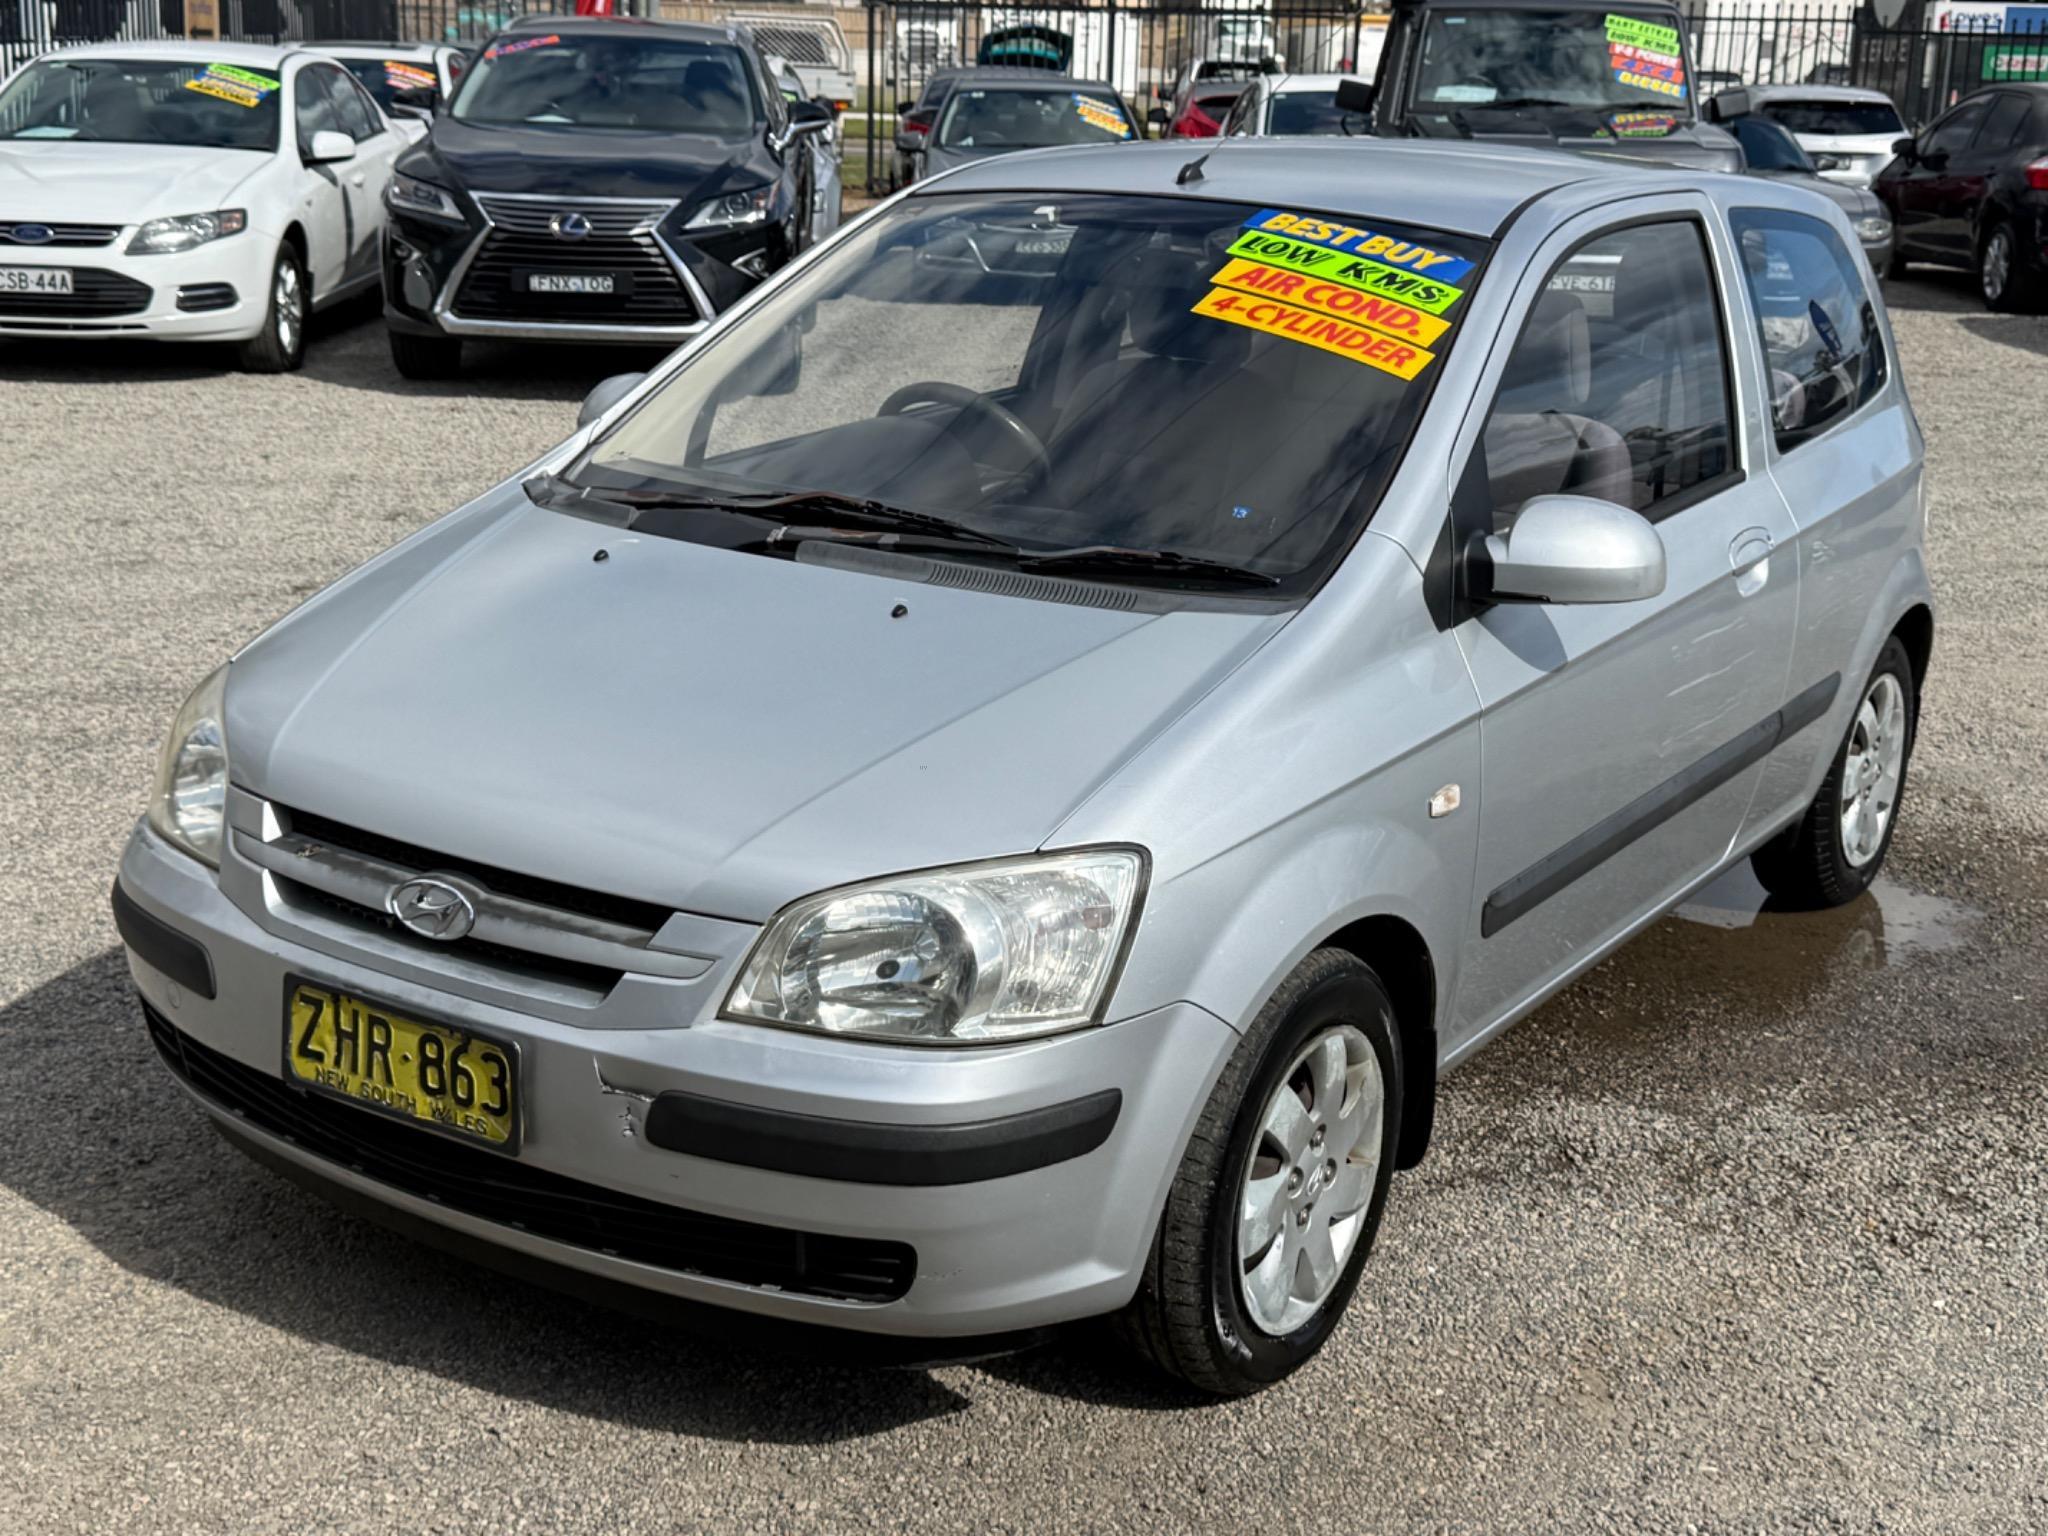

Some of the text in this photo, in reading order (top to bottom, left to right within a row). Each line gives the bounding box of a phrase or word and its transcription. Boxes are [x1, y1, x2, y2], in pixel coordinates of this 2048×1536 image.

[1240, 235, 1450, 305] LOW KMS
[1260, 212, 1455, 270] BEST BUY
[1210, 294, 1418, 369] 4-CYLINDER
[1232, 266, 1424, 336] AIR COND.
[315, 1066, 350, 1091] NEW
[360, 1079, 418, 1116] SOUTH
